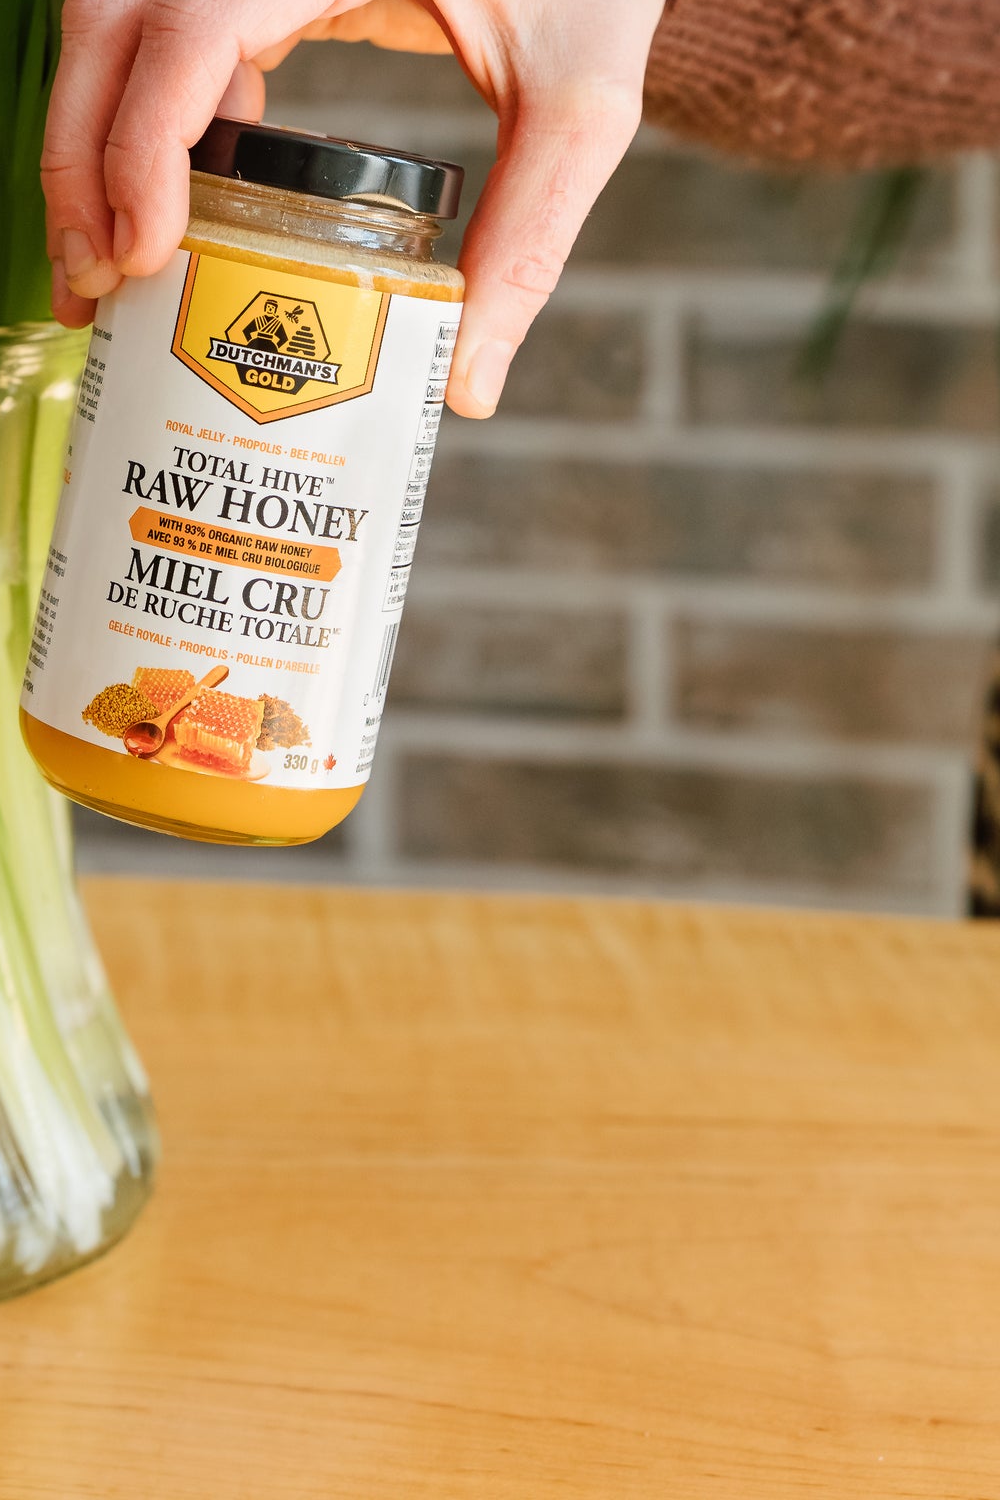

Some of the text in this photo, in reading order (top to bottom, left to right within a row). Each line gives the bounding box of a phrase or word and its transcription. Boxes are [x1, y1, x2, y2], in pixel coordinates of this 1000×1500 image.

[215, 343, 332, 379] DUTCHMAN'S
[245, 369, 296, 391] GOLD
[165, 419, 346, 467] ROYAL JELLY PROPOLIS BEE POLLEN
[173, 445, 254, 485] TOTAL
[121, 459, 369, 542] RAW HONEY
[147, 529, 321, 575] AVEC 93 % DE MIEL CRU BIOLOGIQUE
[158, 516, 313, 559] WITH 93% ORGANIC RAW HONEY
[106, 580, 138, 609] DE
[142, 591, 234, 633] RUCHE
[124, 546, 331, 621] MIEL CRU
[108, 619, 321, 675] GELÉE ROYALE PROPOLIS POLLEN D'ABEILLE
[283, 754, 319, 774] 330 g
